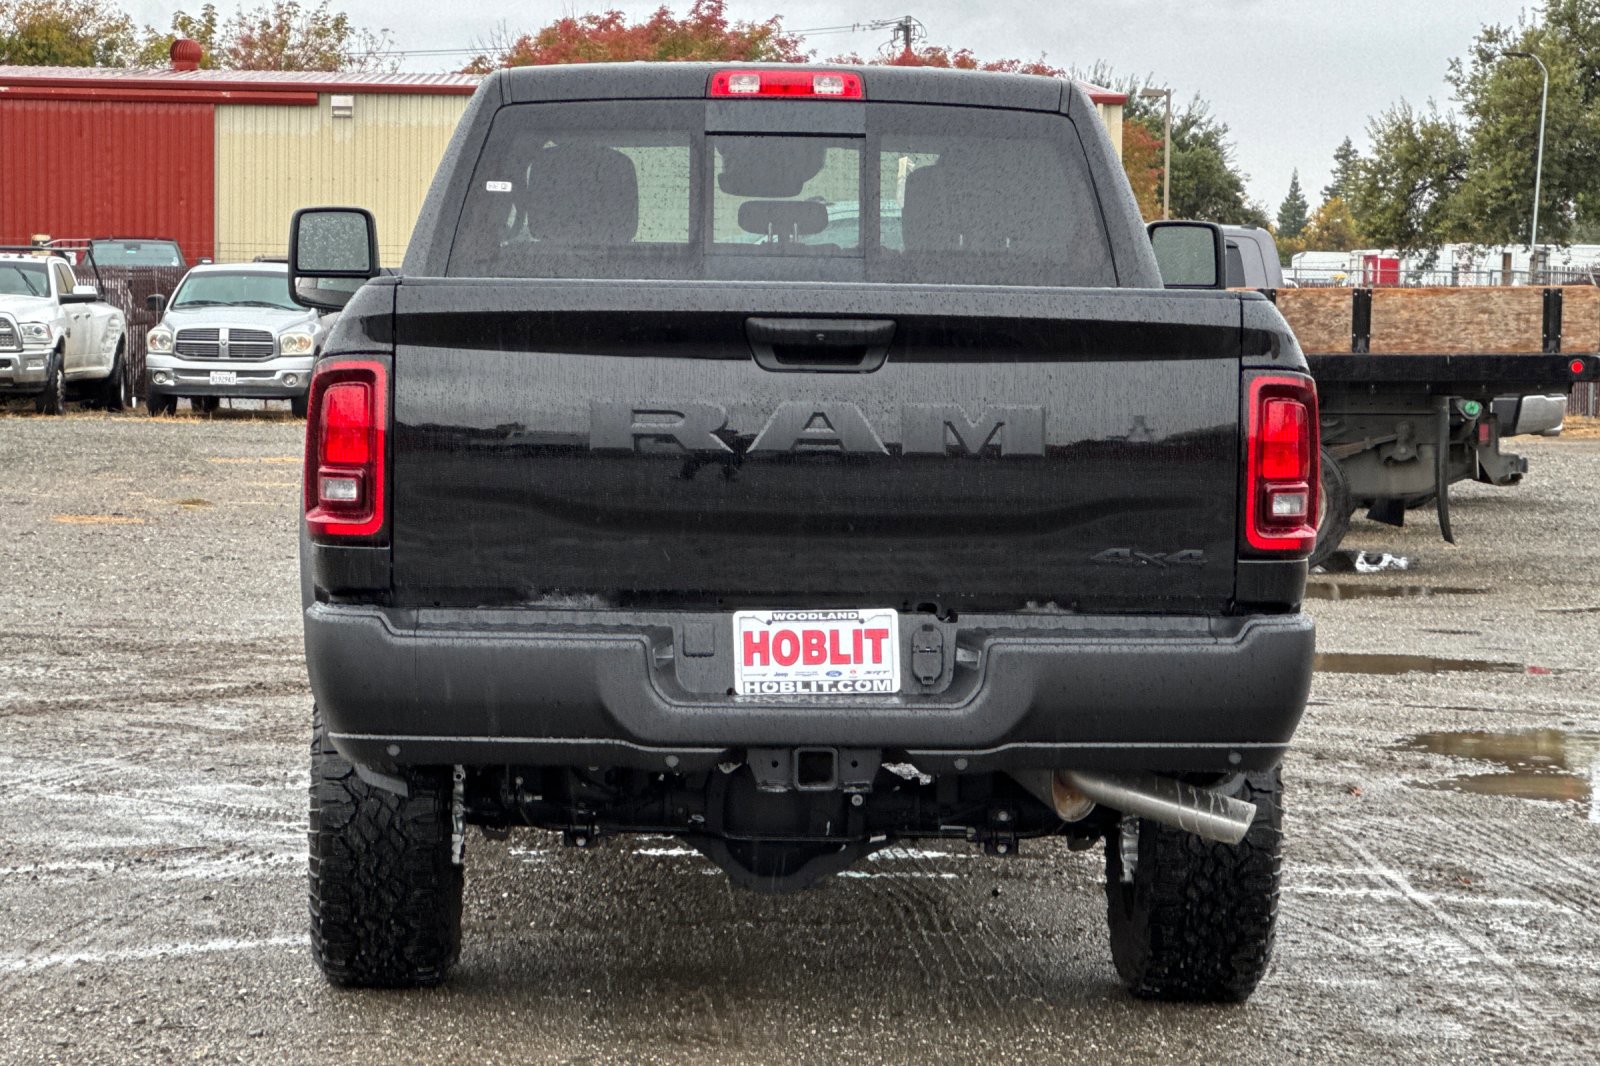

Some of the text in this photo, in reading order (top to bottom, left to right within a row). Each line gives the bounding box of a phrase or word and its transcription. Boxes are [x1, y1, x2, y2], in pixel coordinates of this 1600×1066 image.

[589, 400, 1046, 457] RAM
[773, 612, 859, 621] WOODLAND
[743, 628, 889, 667] HOBLIT
[744, 679, 892, 693] HOBLIT.COM
